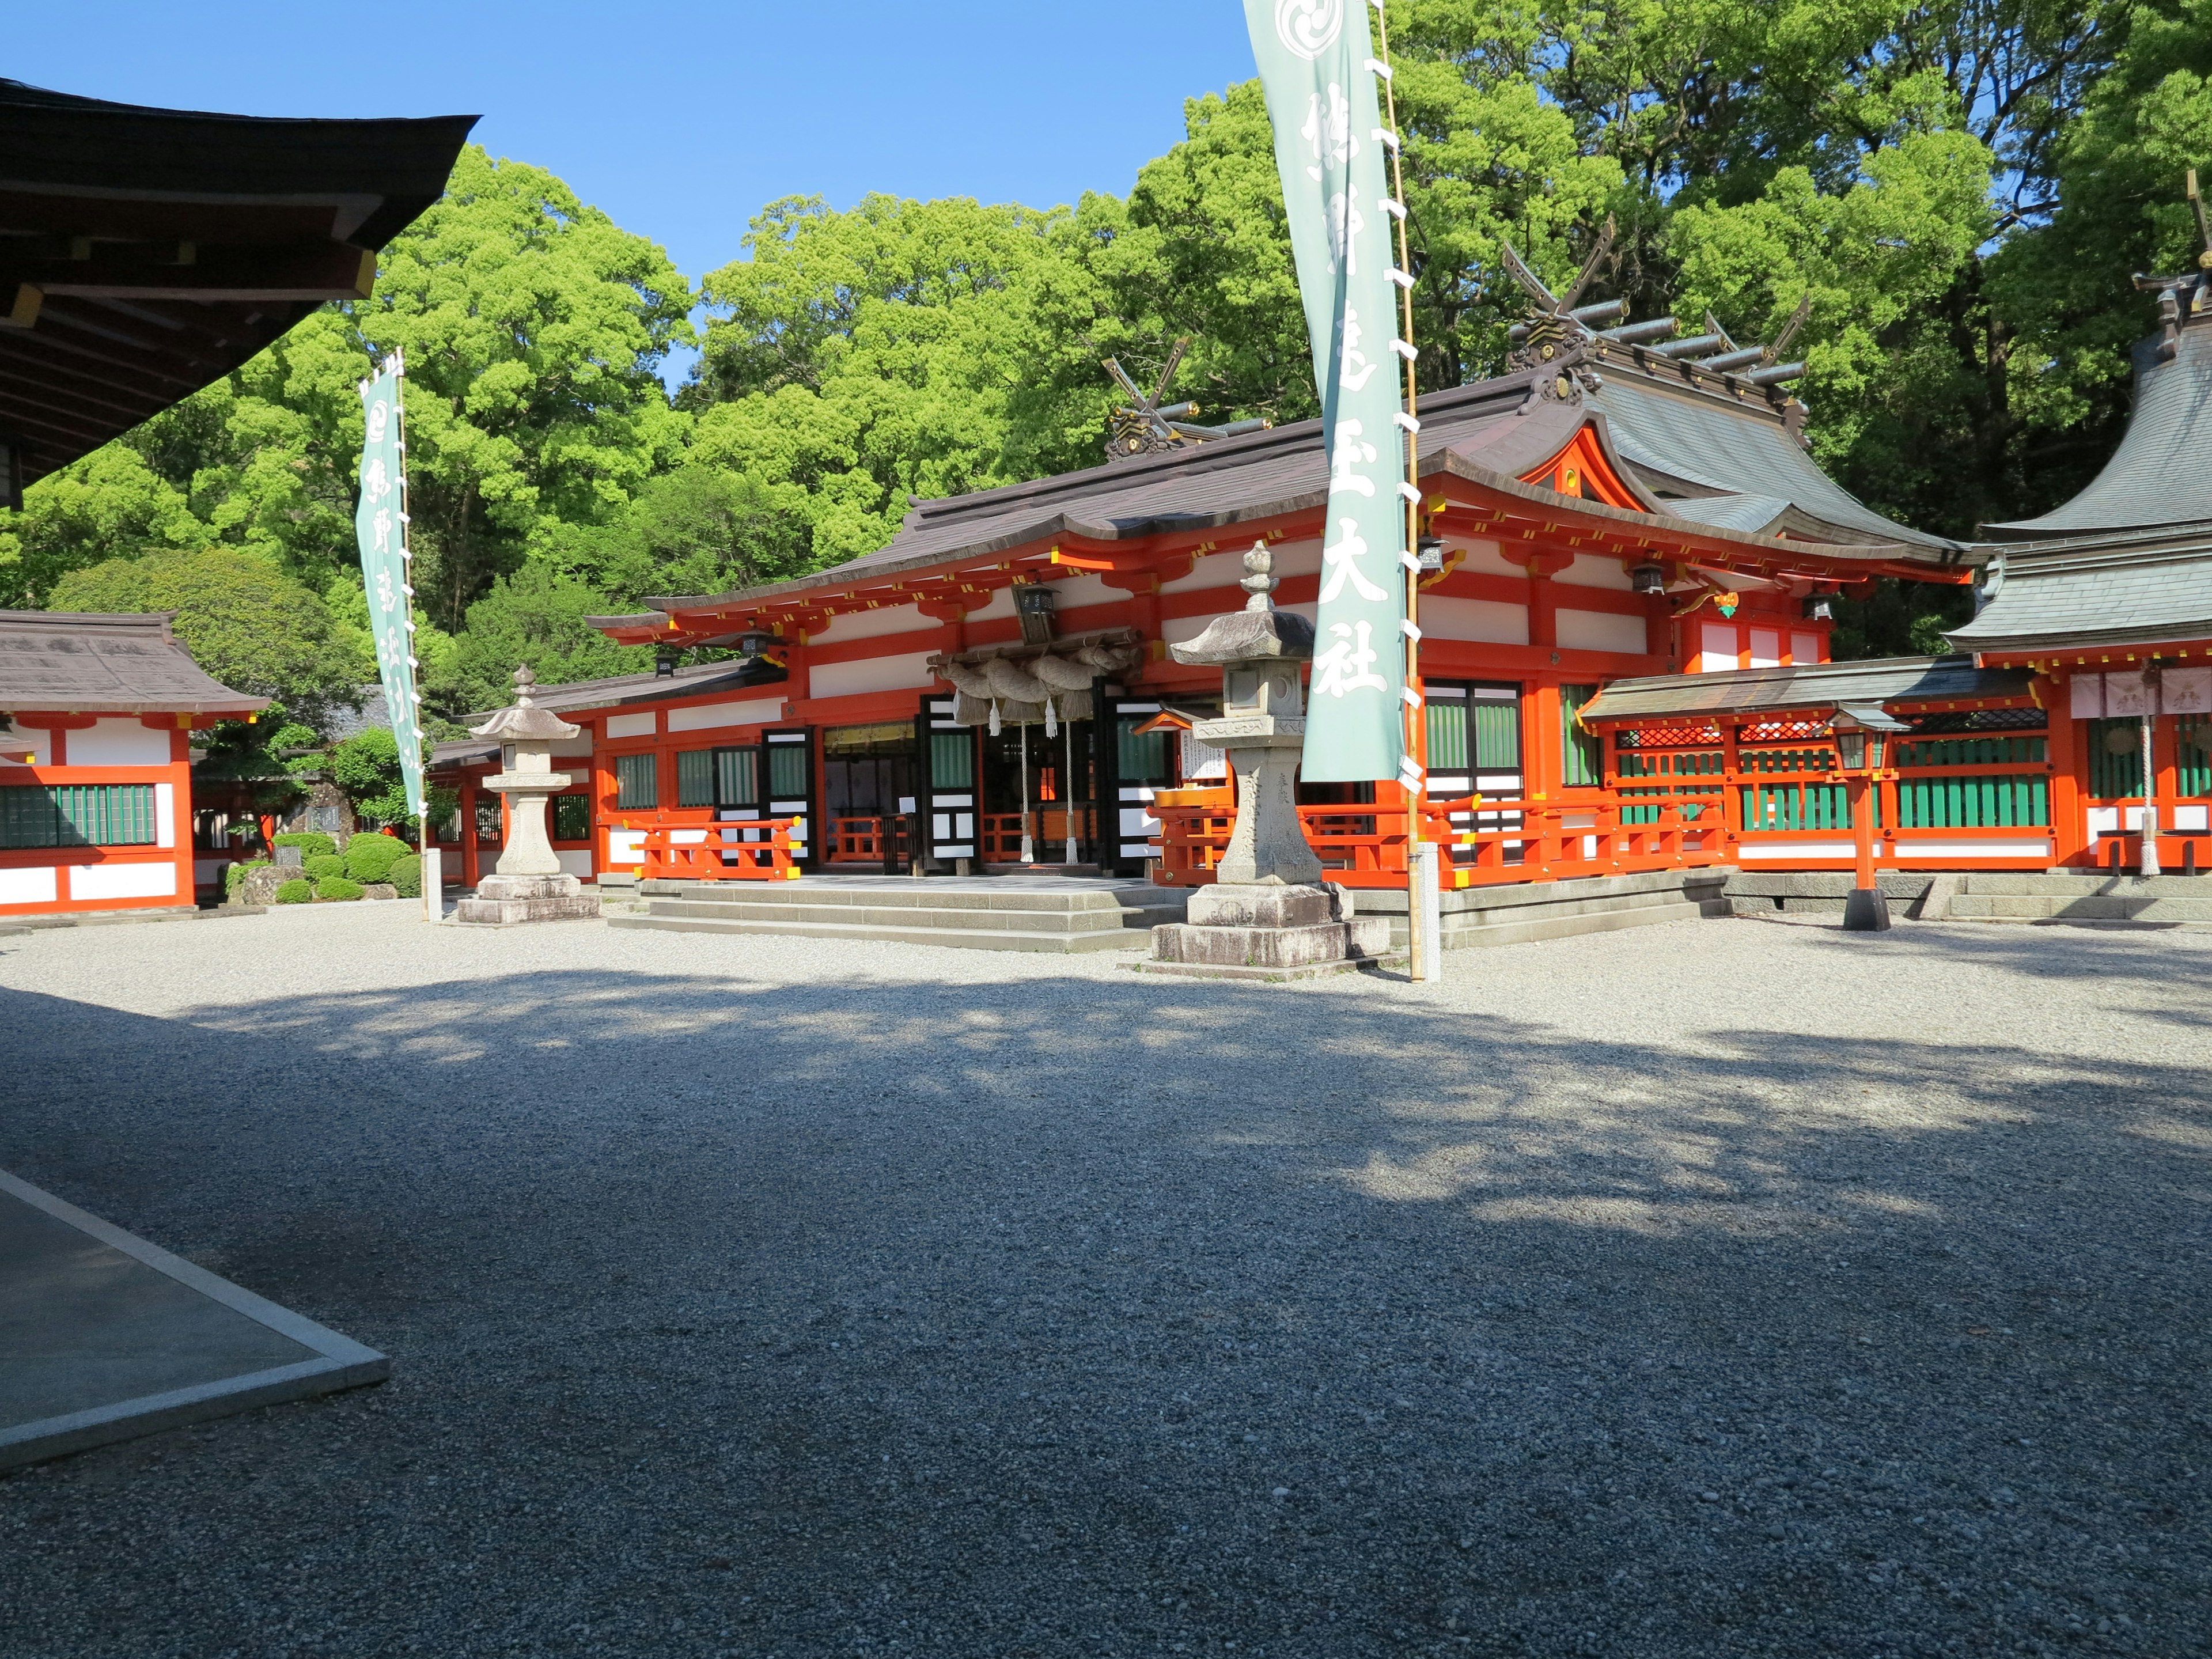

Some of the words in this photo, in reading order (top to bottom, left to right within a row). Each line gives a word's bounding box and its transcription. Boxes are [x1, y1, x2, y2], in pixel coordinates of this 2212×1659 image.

[364, 456, 414, 769] 熊野速玉大
[1300, 81, 1389, 698] 熊野速玉大社
